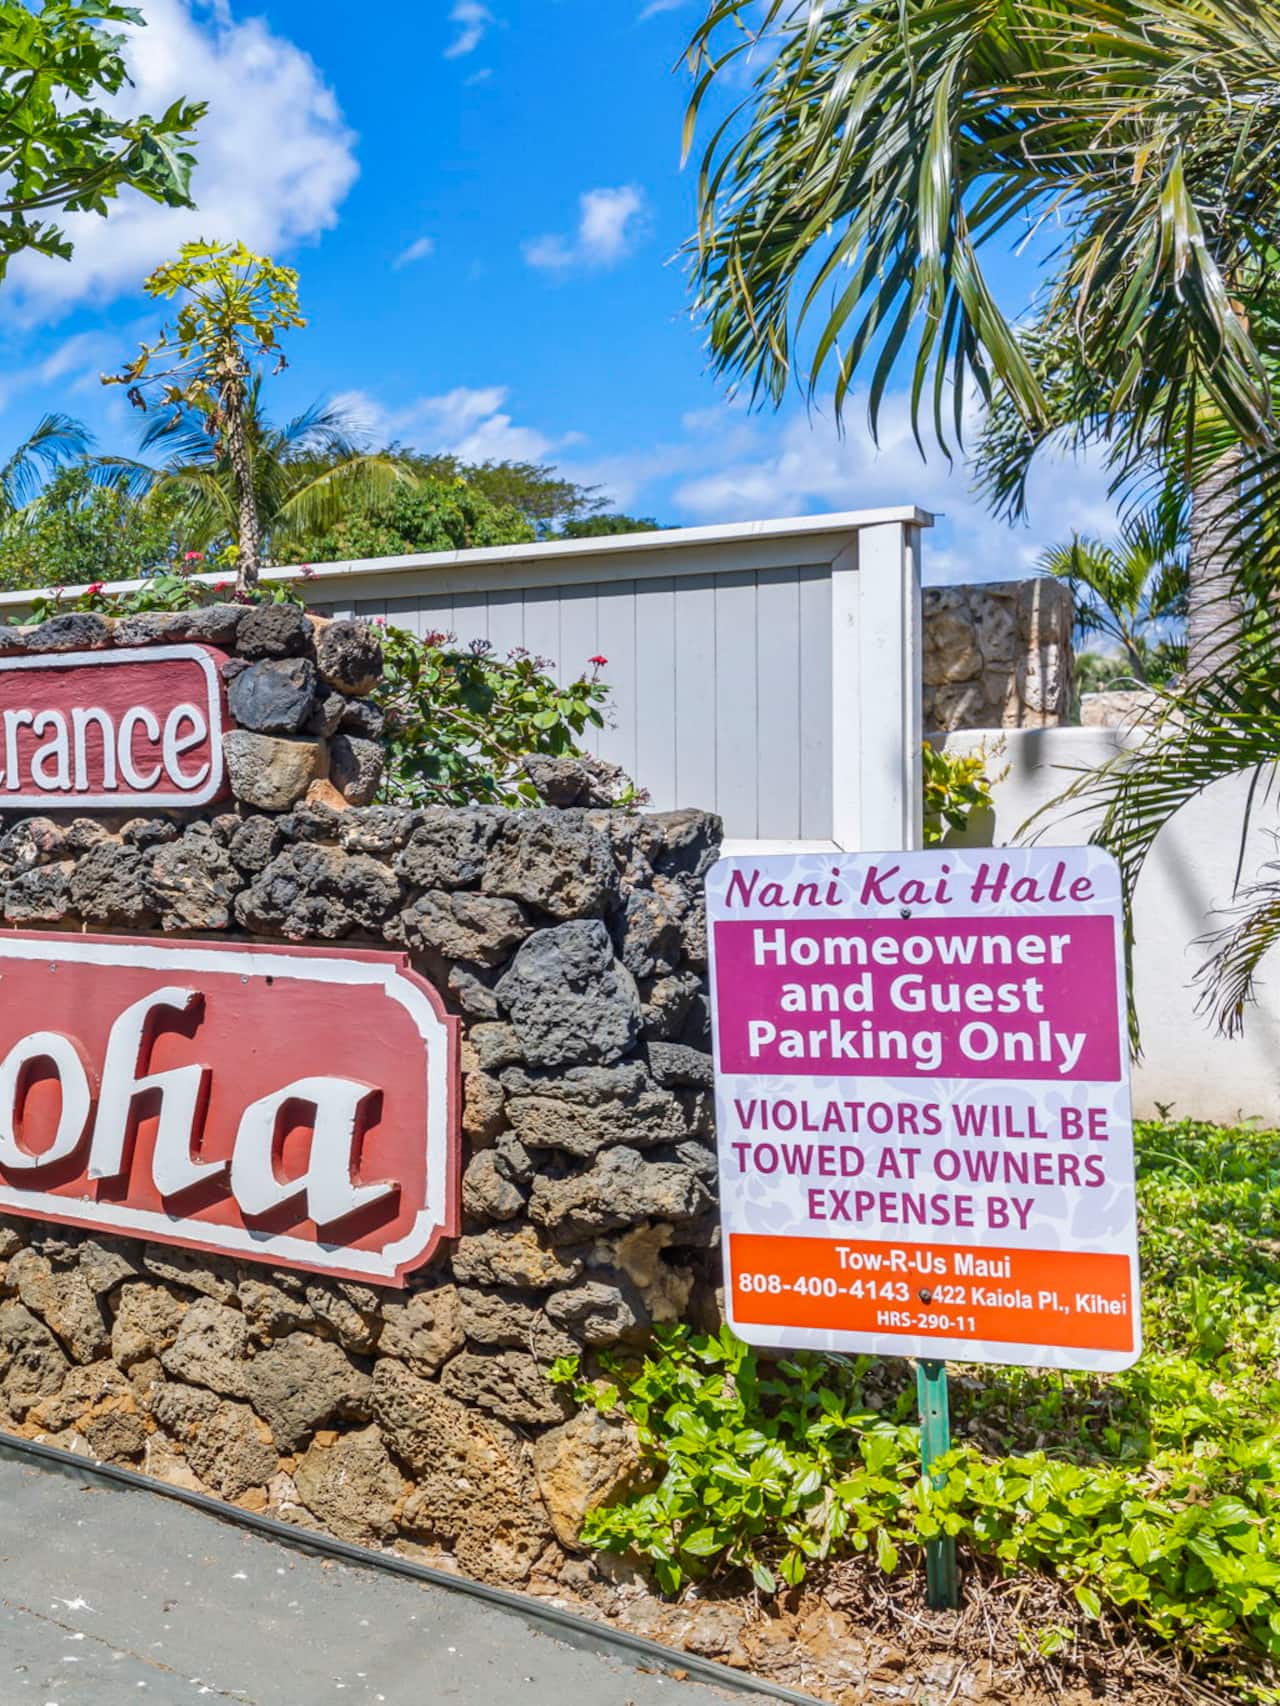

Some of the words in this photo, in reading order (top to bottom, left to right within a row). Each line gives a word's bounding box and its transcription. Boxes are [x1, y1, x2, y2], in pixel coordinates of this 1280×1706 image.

[724, 867, 844, 909] Nani
[859, 864, 953, 906] Kai
[970, 861, 1095, 903] Hale
[753, 928, 1071, 967] Homeowner
[780, 972, 874, 1013] and
[890, 974, 1045, 1014] Guest
[747, 1018, 942, 1071] Parking
[958, 1020, 1087, 1074] Only
[734, 1099, 942, 1136] VIOLATORS
[952, 1104, 1048, 1140] WILL
[1060, 1107, 1109, 1141] BE
[732, 1142, 865, 1178] TOWED
[877, 1147, 921, 1179] AT
[933, 1149, 1106, 1188] OWNERS
[807, 1188, 974, 1227] EXPENSE
[987, 1197, 1035, 1230] BY
[835, 1246, 947, 1275] Tow-R-Us
[954, 1253, 1011, 1279] Maui
[738, 1273, 910, 1302] 808-400-4143
[932, 1285, 966, 1305] 422
[971, 1287, 1033, 1310] Kaiola
[1038, 1291, 1070, 1315] Pl.,
[1075, 1293, 1127, 1317] Kihei
[877, 1310, 976, 1332] HRS-290-11
